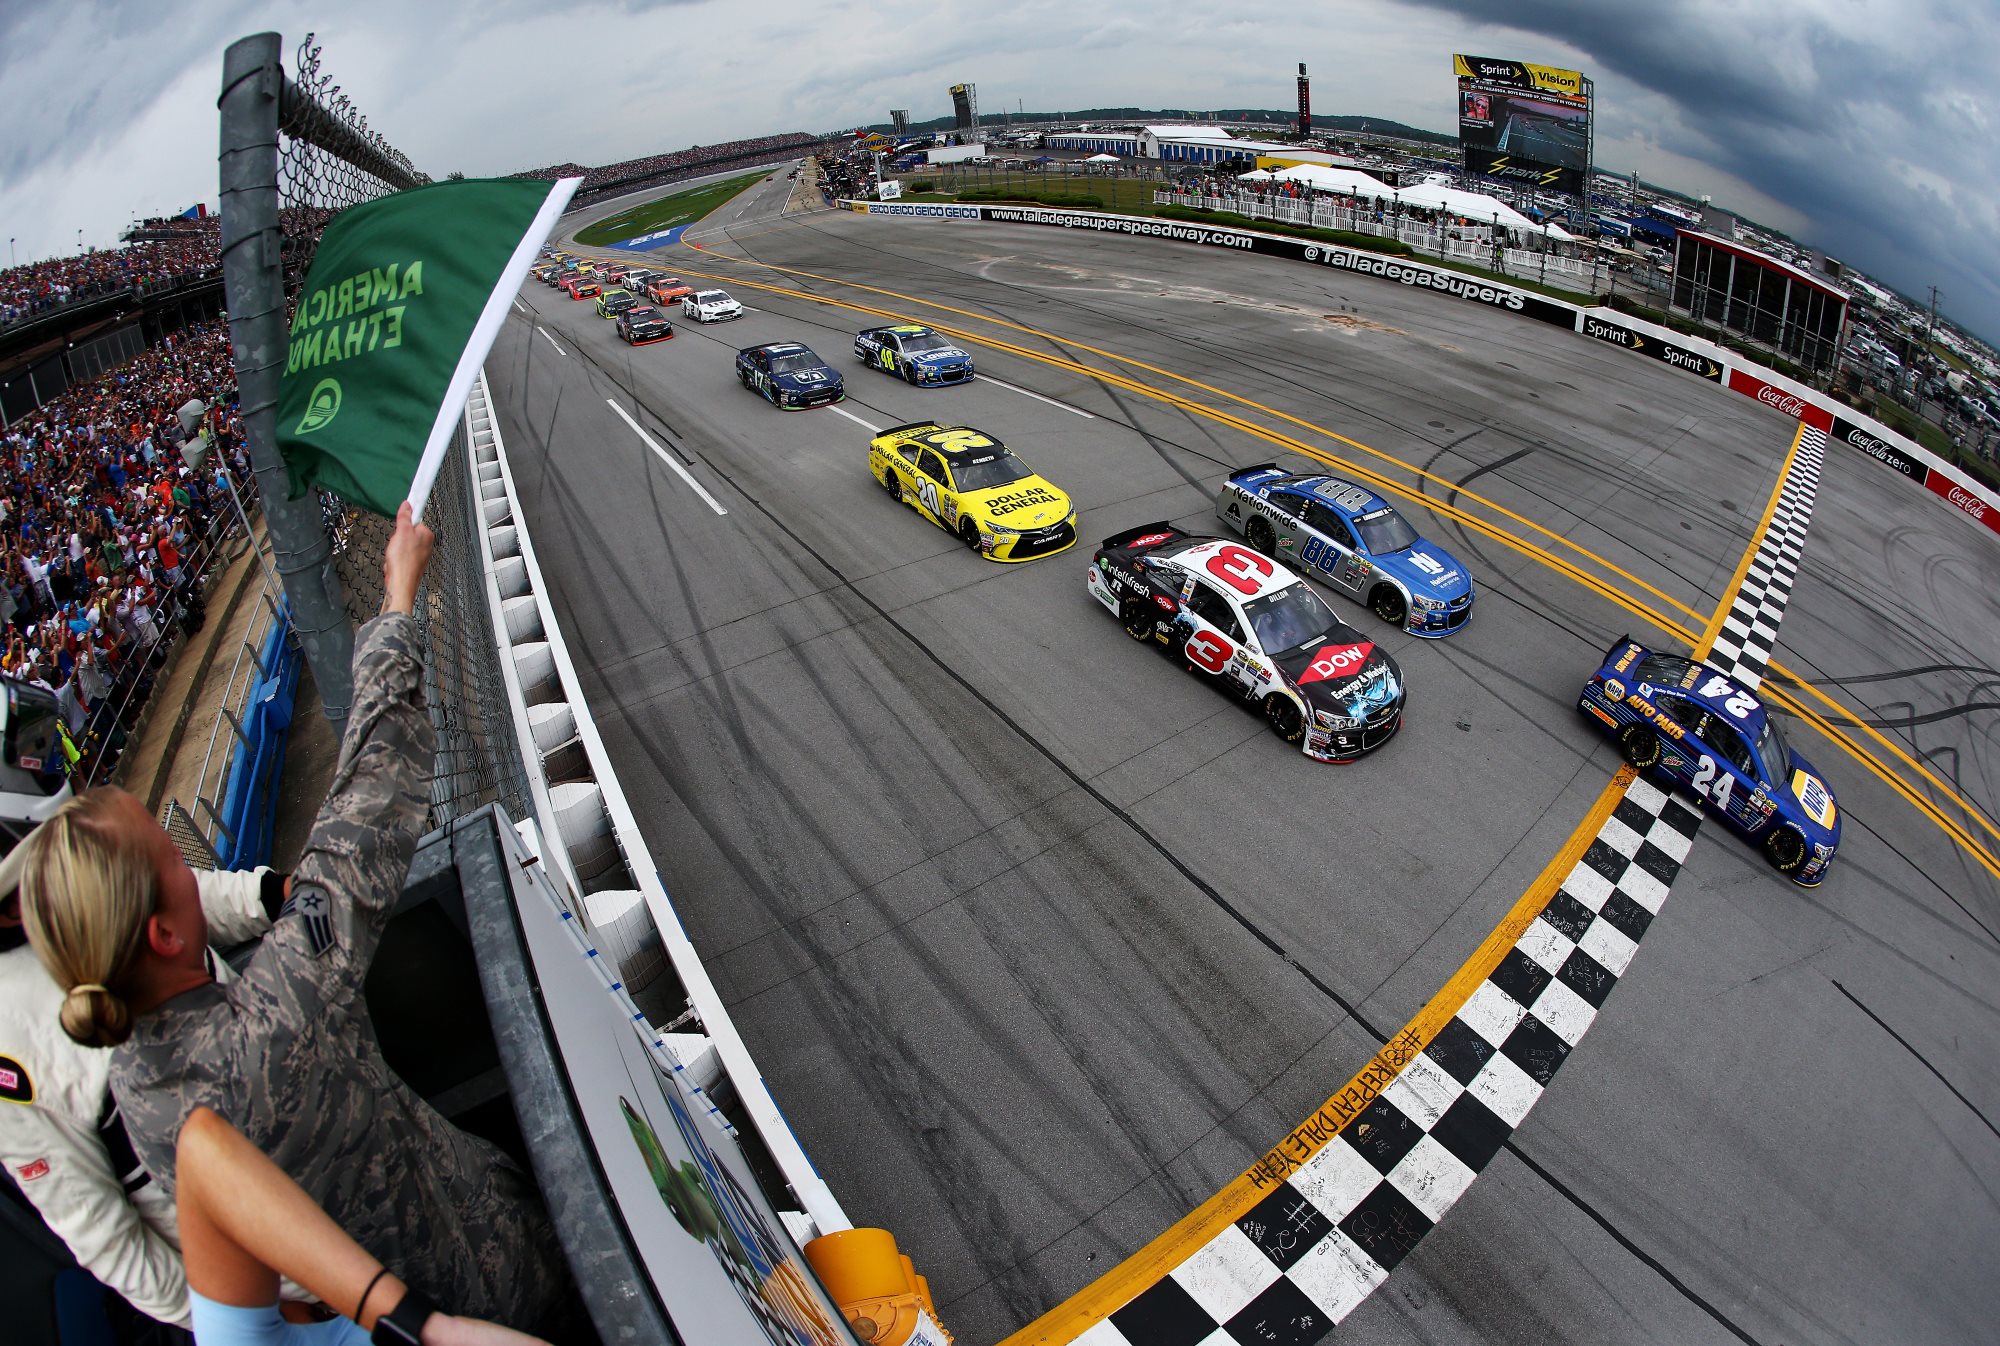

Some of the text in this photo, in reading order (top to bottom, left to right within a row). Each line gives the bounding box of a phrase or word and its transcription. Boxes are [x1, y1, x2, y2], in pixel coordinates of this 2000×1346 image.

[1480, 63, 1511, 76] Sprint
[1538, 71, 1575, 87] Vision
[857, 138, 895, 149] SUNOCO
[869, 204, 889, 214] GEICO
[890, 205, 914, 216] GEICO
[915, 206, 944, 217] GEICO
[945, 206, 978, 218] GEICO
[991, 209, 1253, 249] www.talladegasuperspeedway.com
[1588, 319, 1627, 345] Sprint
[881, 348, 895, 370] 48
[1664, 346, 1702, 373] Sprint
[754, 370, 764, 389] 17
[1757, 385, 1806, 418] Coca-Cola
[876, 445, 917, 479] DOLLAR GENERAL
[1848, 429, 1911, 474] Coca-Cola zero
[916, 476, 941, 516] 20
[984, 487, 1048, 508] DOLLAR
[990, 494, 1061, 516] GENERAL
[1233, 487, 1298, 531] Nationwide
[1314, 480, 1373, 512] 88
[1948, 486, 1987, 519] Coca-Cola
[1224, 513, 1241, 525] AXALTA
[1000, 536, 1009, 544] 20
[1033, 532, 1063, 545] CAMRY
[1301, 535, 1343, 574] 88
[1206, 546, 1274, 595] 3
[1430, 570, 1459, 586] Nationwide
[1268, 590, 1289, 603] DILLON
[1186, 630, 1234, 673] 3
[1311, 645, 1364, 678] DOW
[1260, 668, 1272, 679] 3M
[1331, 664, 1388, 700] Energy & Water
[1607, 680, 1623, 699] NAPA
[1698, 675, 1760, 719] 24
[1312, 723, 1332, 733] MOOG
[1626, 695, 1656, 717] AUTO
[1653, 713, 1685, 739] PARTS
[1338, 736, 1347, 745] 3
[1622, 727, 1635, 742] EAGLE
[1637, 741, 1660, 767] GOODYEAR
[1692, 755, 1735, 812] 24
[1761, 805, 1774, 816] 3M
[1800, 778, 1827, 819] NAPA
[1768, 829, 1781, 845] EAGLE
[1779, 843, 1805, 870] GOODYEAR
[1332, 1058, 1393, 1125] REPEAT
[1286, 1111, 1340, 1159] DALE
[1246, 1148, 1302, 1190] YEAH
[1266, 1200, 1318, 1262] #24
[1352, 1210, 1380, 1237] GO
[1317, 1230, 1341, 1256] GO 19
